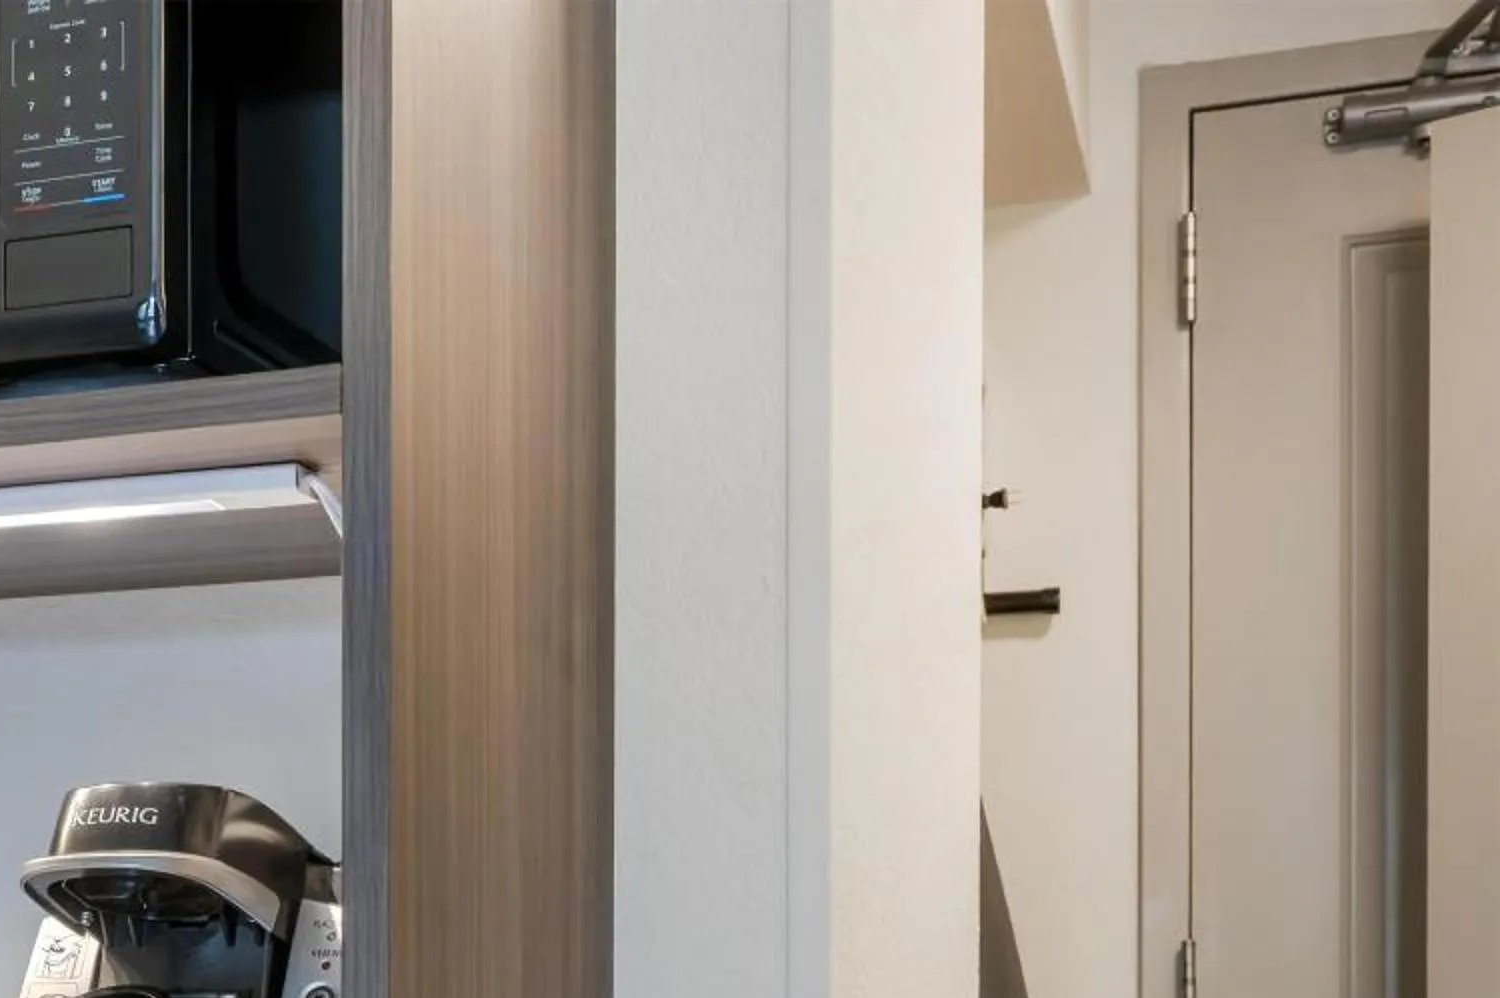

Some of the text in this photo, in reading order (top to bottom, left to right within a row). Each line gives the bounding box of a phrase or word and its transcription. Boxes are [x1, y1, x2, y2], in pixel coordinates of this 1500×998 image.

[63, 33, 72, 44] 2
[27, 71, 35, 81] 4
[63, 65, 72, 77] 5
[27, 101, 35, 112] 7
[71, 807, 158, 826] KEURIG
